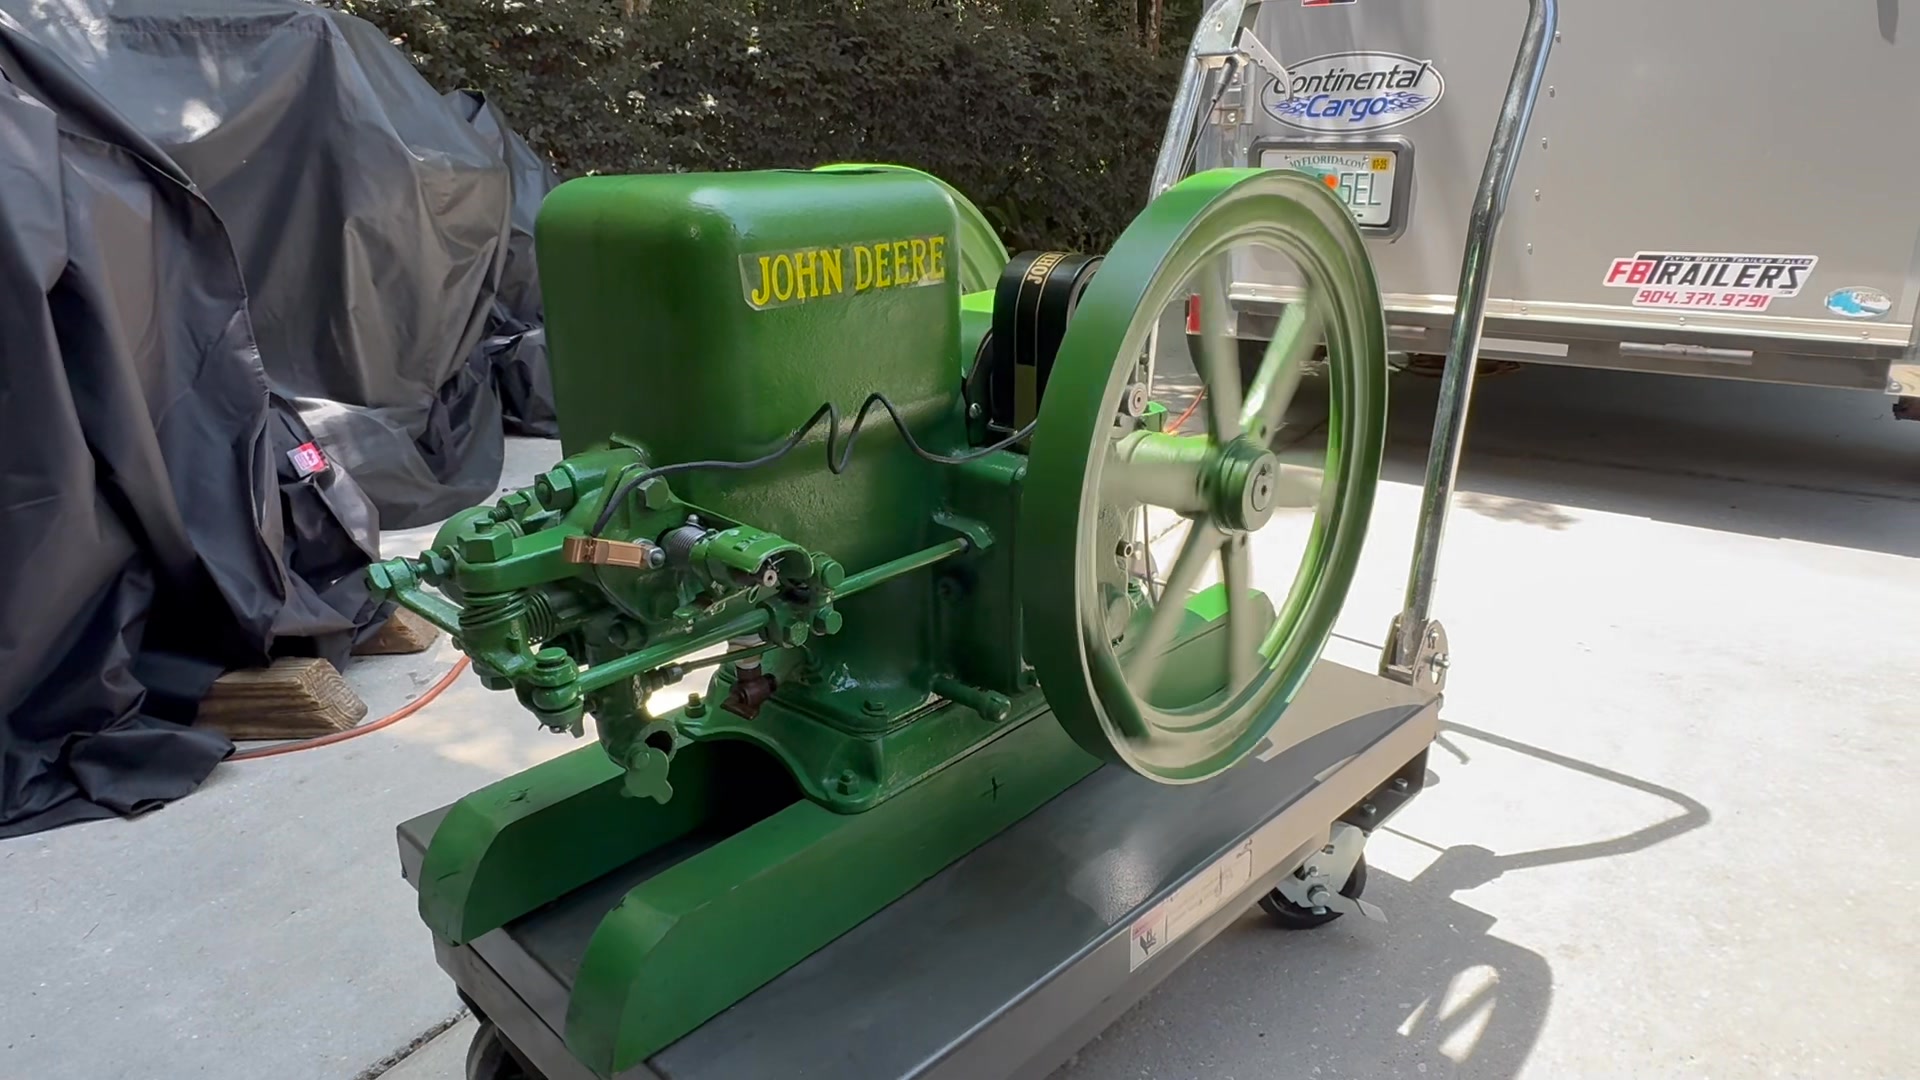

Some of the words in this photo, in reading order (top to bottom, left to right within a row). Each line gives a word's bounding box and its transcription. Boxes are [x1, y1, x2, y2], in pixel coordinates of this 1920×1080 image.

[1273, 62, 1428, 94] Continental
[1306, 94, 1388, 122] Cargo
[751, 249, 843, 306] JOHN
[853, 236, 945, 291] DEERE
[1636, 290, 1770, 308] 904.371.9791
